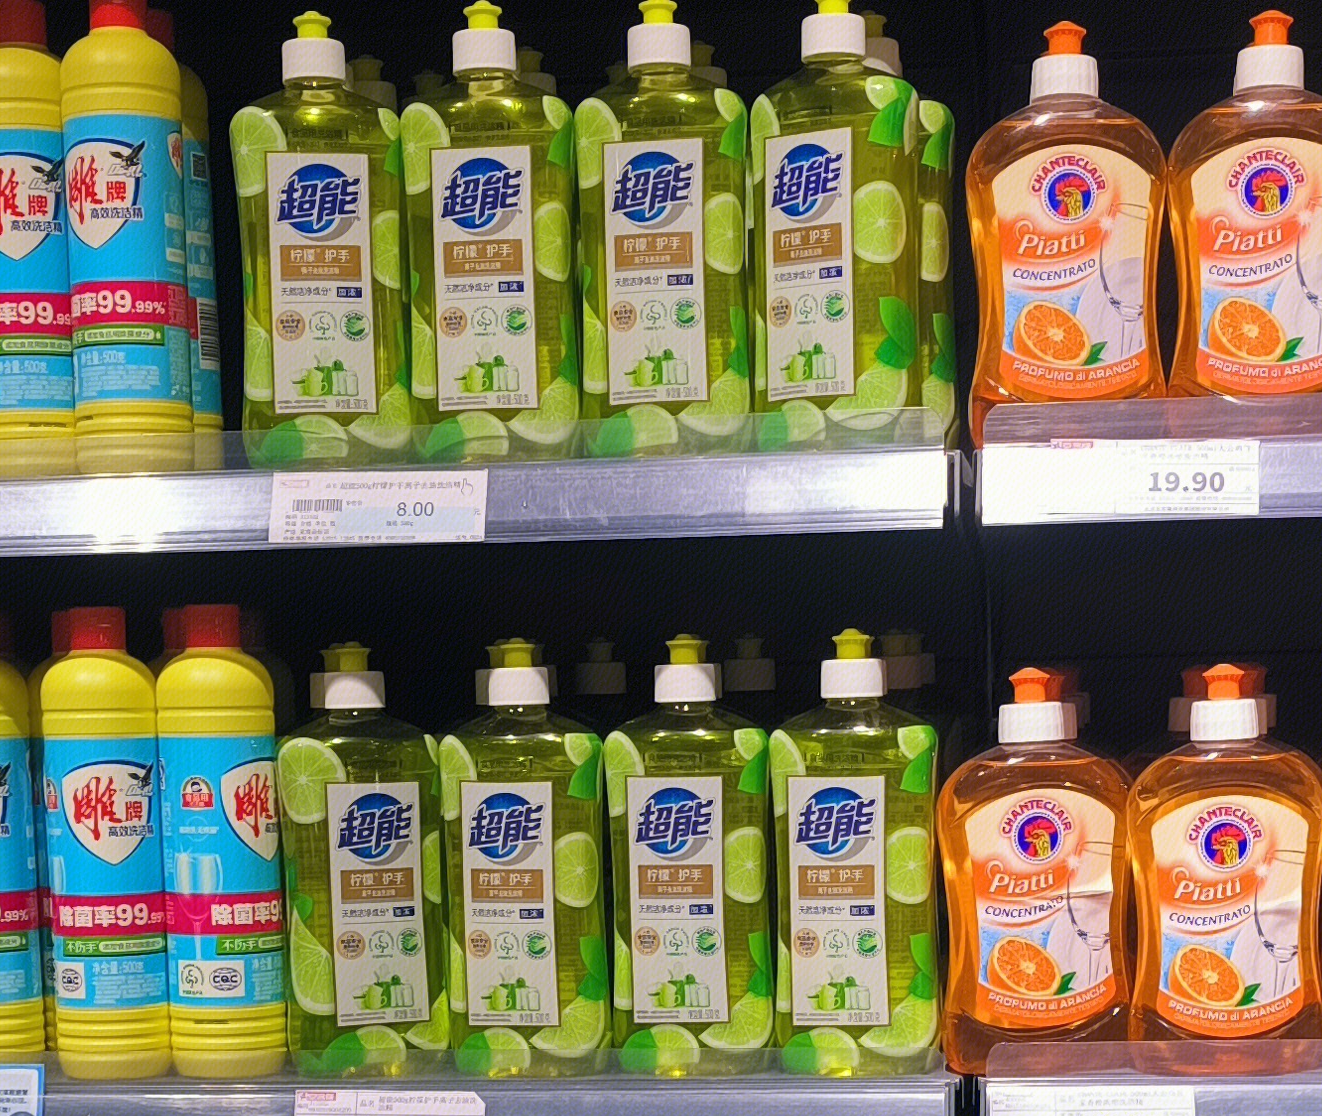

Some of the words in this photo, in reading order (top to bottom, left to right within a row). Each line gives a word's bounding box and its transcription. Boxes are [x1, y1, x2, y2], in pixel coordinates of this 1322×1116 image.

[1030, 154, 1106, 194] CHANTECLAIR
[275, 176, 361, 227] 超能
[611, 161, 694, 216] 超能
[90, 206, 144, 220] 高效洗洁精
[1016, 230, 1086, 256] Piatti
[1209, 254, 1293, 278] CONCENTRATO
[1012, 359, 1073, 382] PROFUMO
[1087, 357, 1141, 381] ARANCIA
[1148, 472, 1225, 492] 19.90
[397, 502, 434, 517] 8.00
[338, 803, 412, 853] 超能
[636, 800, 713, 849] 超能
[1001, 799, 1072, 835] CHANTECLAIR
[1189, 806, 1263, 842] CHANTECLAIR
[989, 870, 1053, 894] Piatti
[1174, 878, 1241, 902] Piatti
